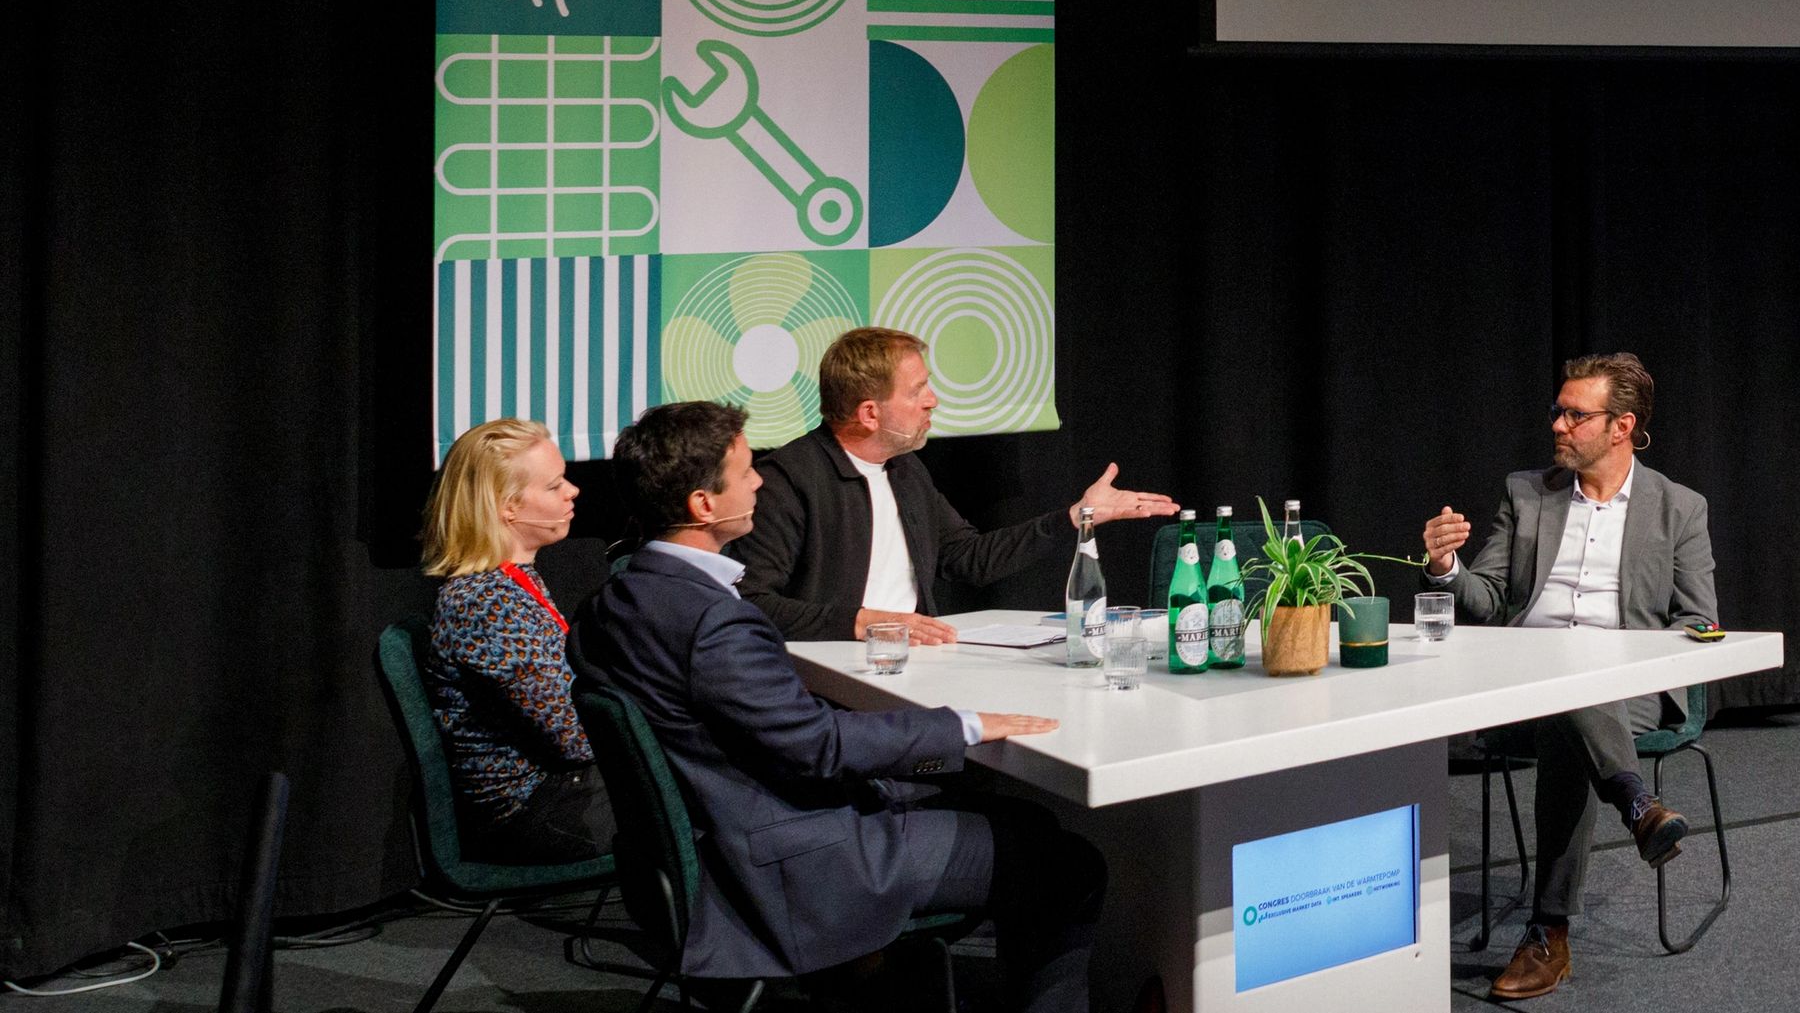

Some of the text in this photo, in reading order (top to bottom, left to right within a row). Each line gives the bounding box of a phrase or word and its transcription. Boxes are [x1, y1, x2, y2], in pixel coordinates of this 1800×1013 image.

[1258, 869, 1401, 911] CONGRES DOORBRAAK VAN DE WARMTEPOMP
